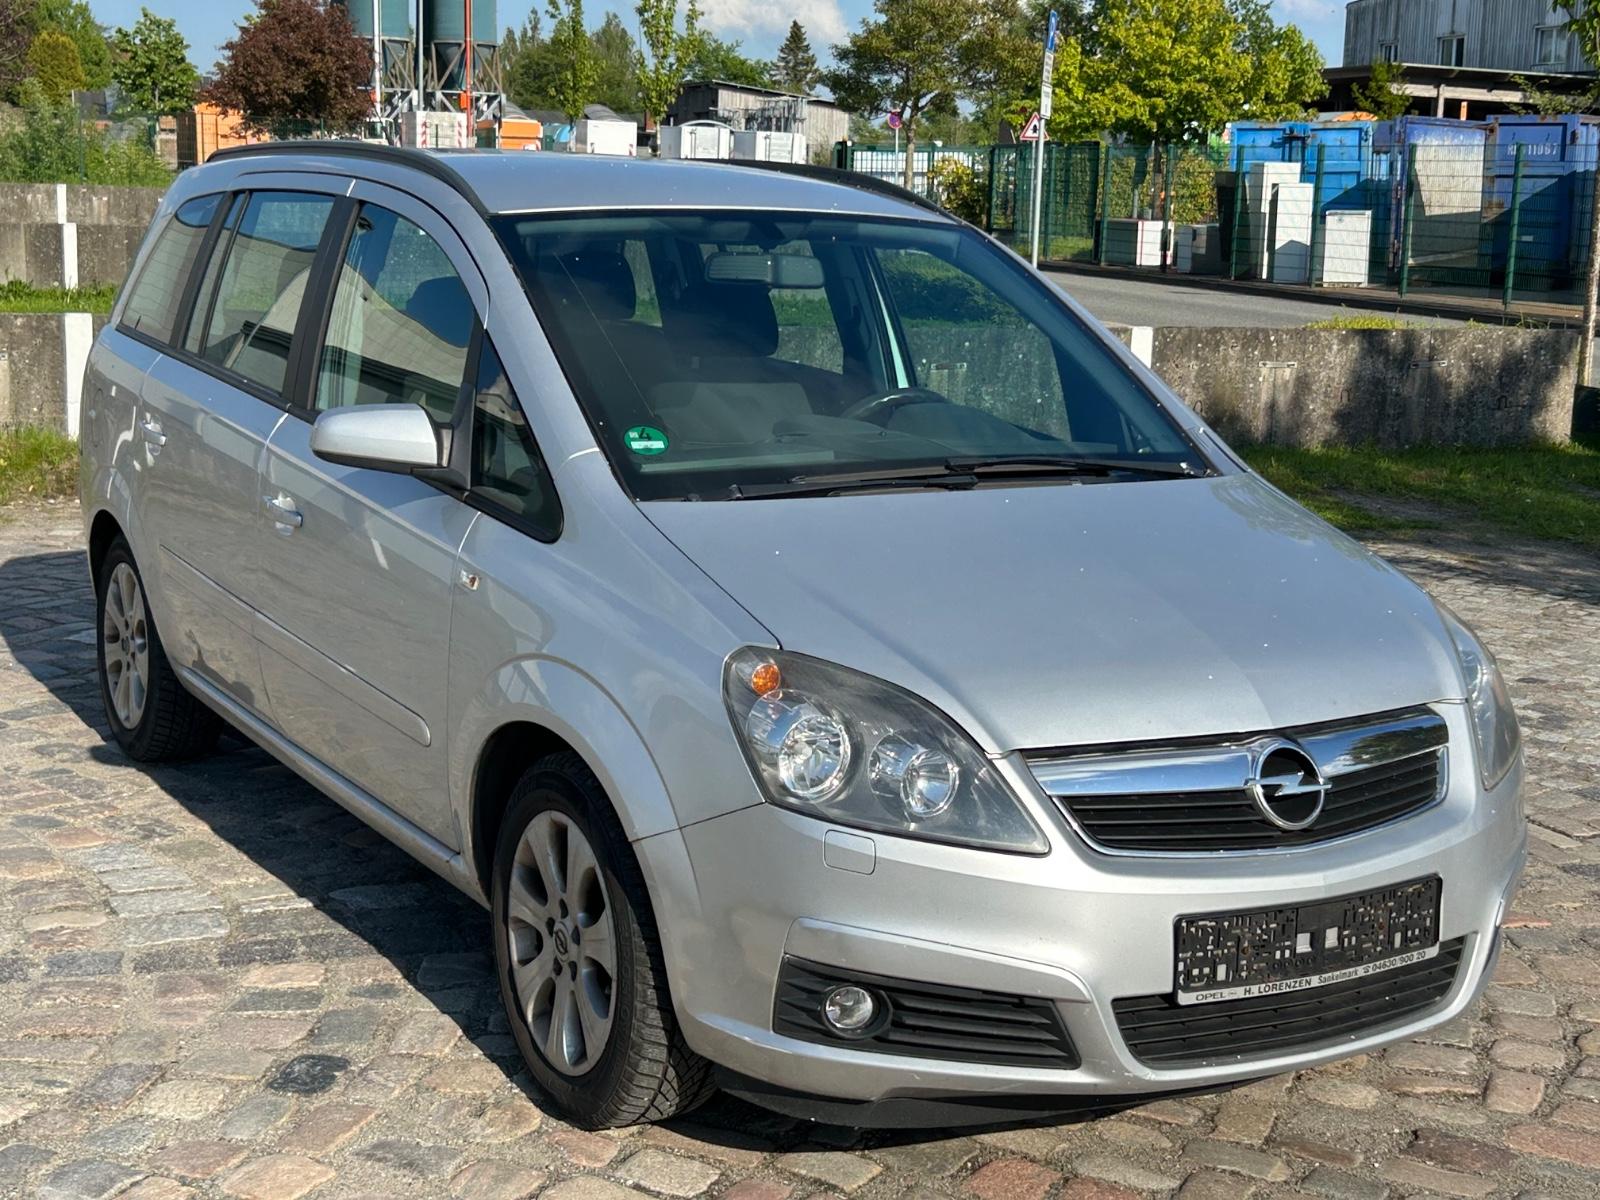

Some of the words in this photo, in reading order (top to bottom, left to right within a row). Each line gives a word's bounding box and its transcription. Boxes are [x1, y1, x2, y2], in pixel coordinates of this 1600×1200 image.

[639, 427, 651, 441] 4
[1195, 991, 1225, 1002] OPEL
[1243, 986, 1254, 996] H.
[1257, 977, 1312, 994] LORENZEN
[1318, 967, 1358, 984] Sankelmark
